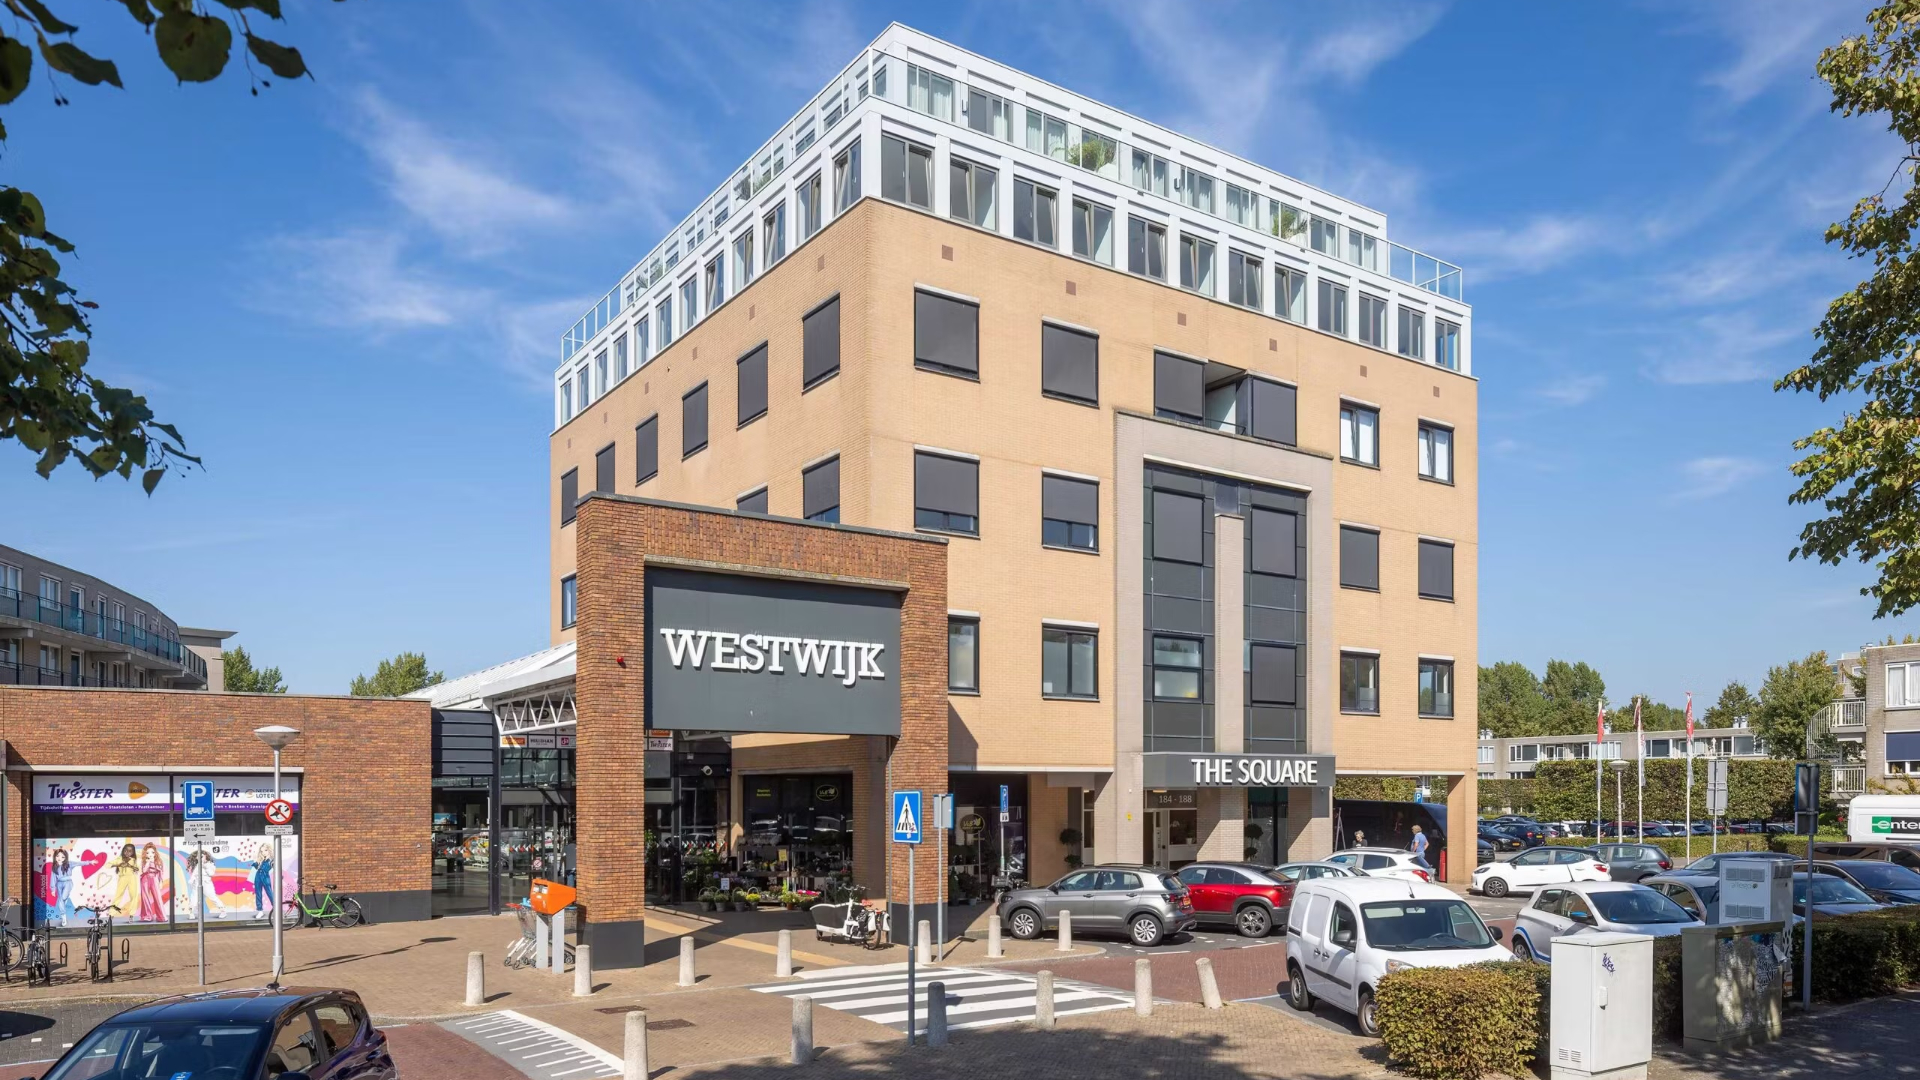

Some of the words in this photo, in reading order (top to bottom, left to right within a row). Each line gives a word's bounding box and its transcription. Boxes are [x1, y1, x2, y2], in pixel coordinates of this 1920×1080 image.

[660, 628, 885, 686] WESTWIJK
[1191, 758, 1233, 784] THE
[1237, 759, 1318, 786] SQUARE
[191, 784, 207, 805] P
[1159, 795, 1172, 803] 184
[1178, 795, 1192, 803] 188
